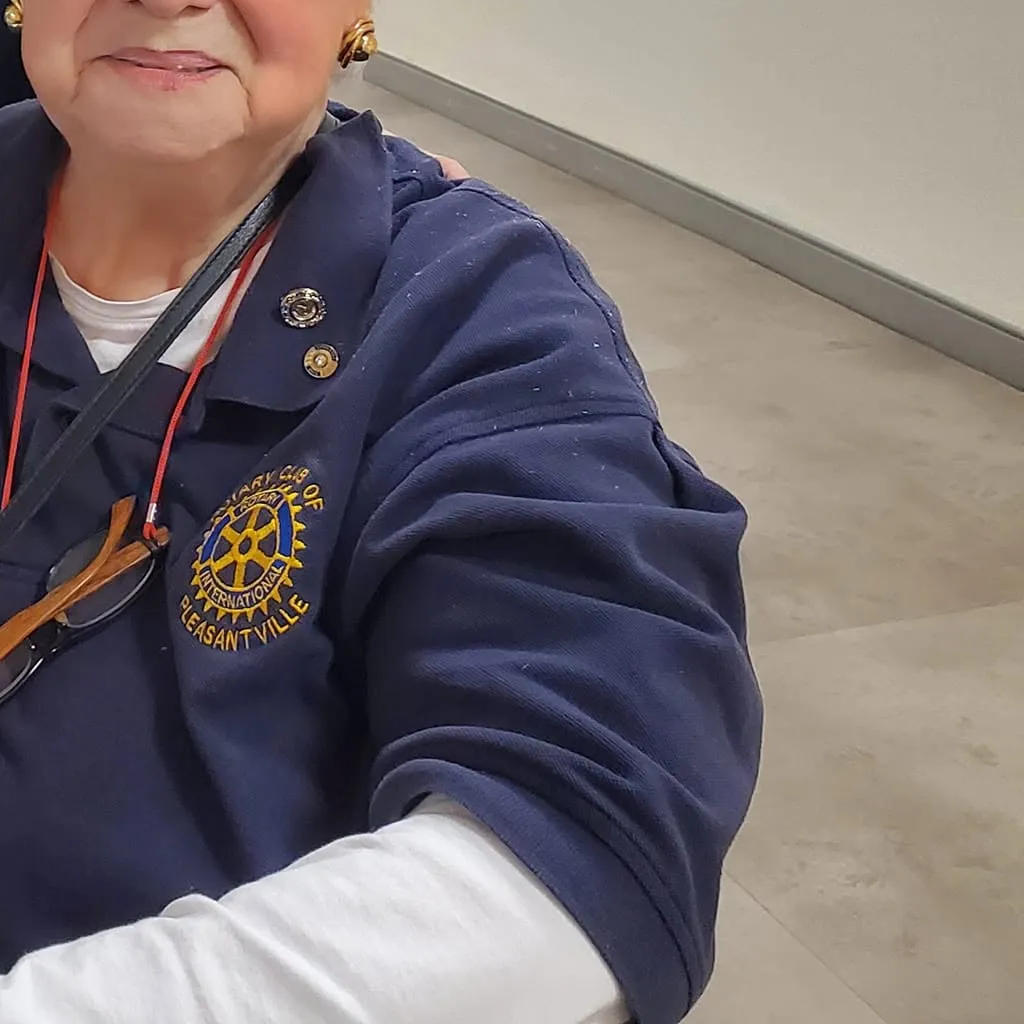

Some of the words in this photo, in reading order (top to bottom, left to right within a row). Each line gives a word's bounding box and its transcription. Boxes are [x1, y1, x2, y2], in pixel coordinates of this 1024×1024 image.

[302, 484, 325, 511] OF
[200, 566, 285, 608] INTERNATIONAL
[179, 594, 310, 652] PLEASANTVILLE
